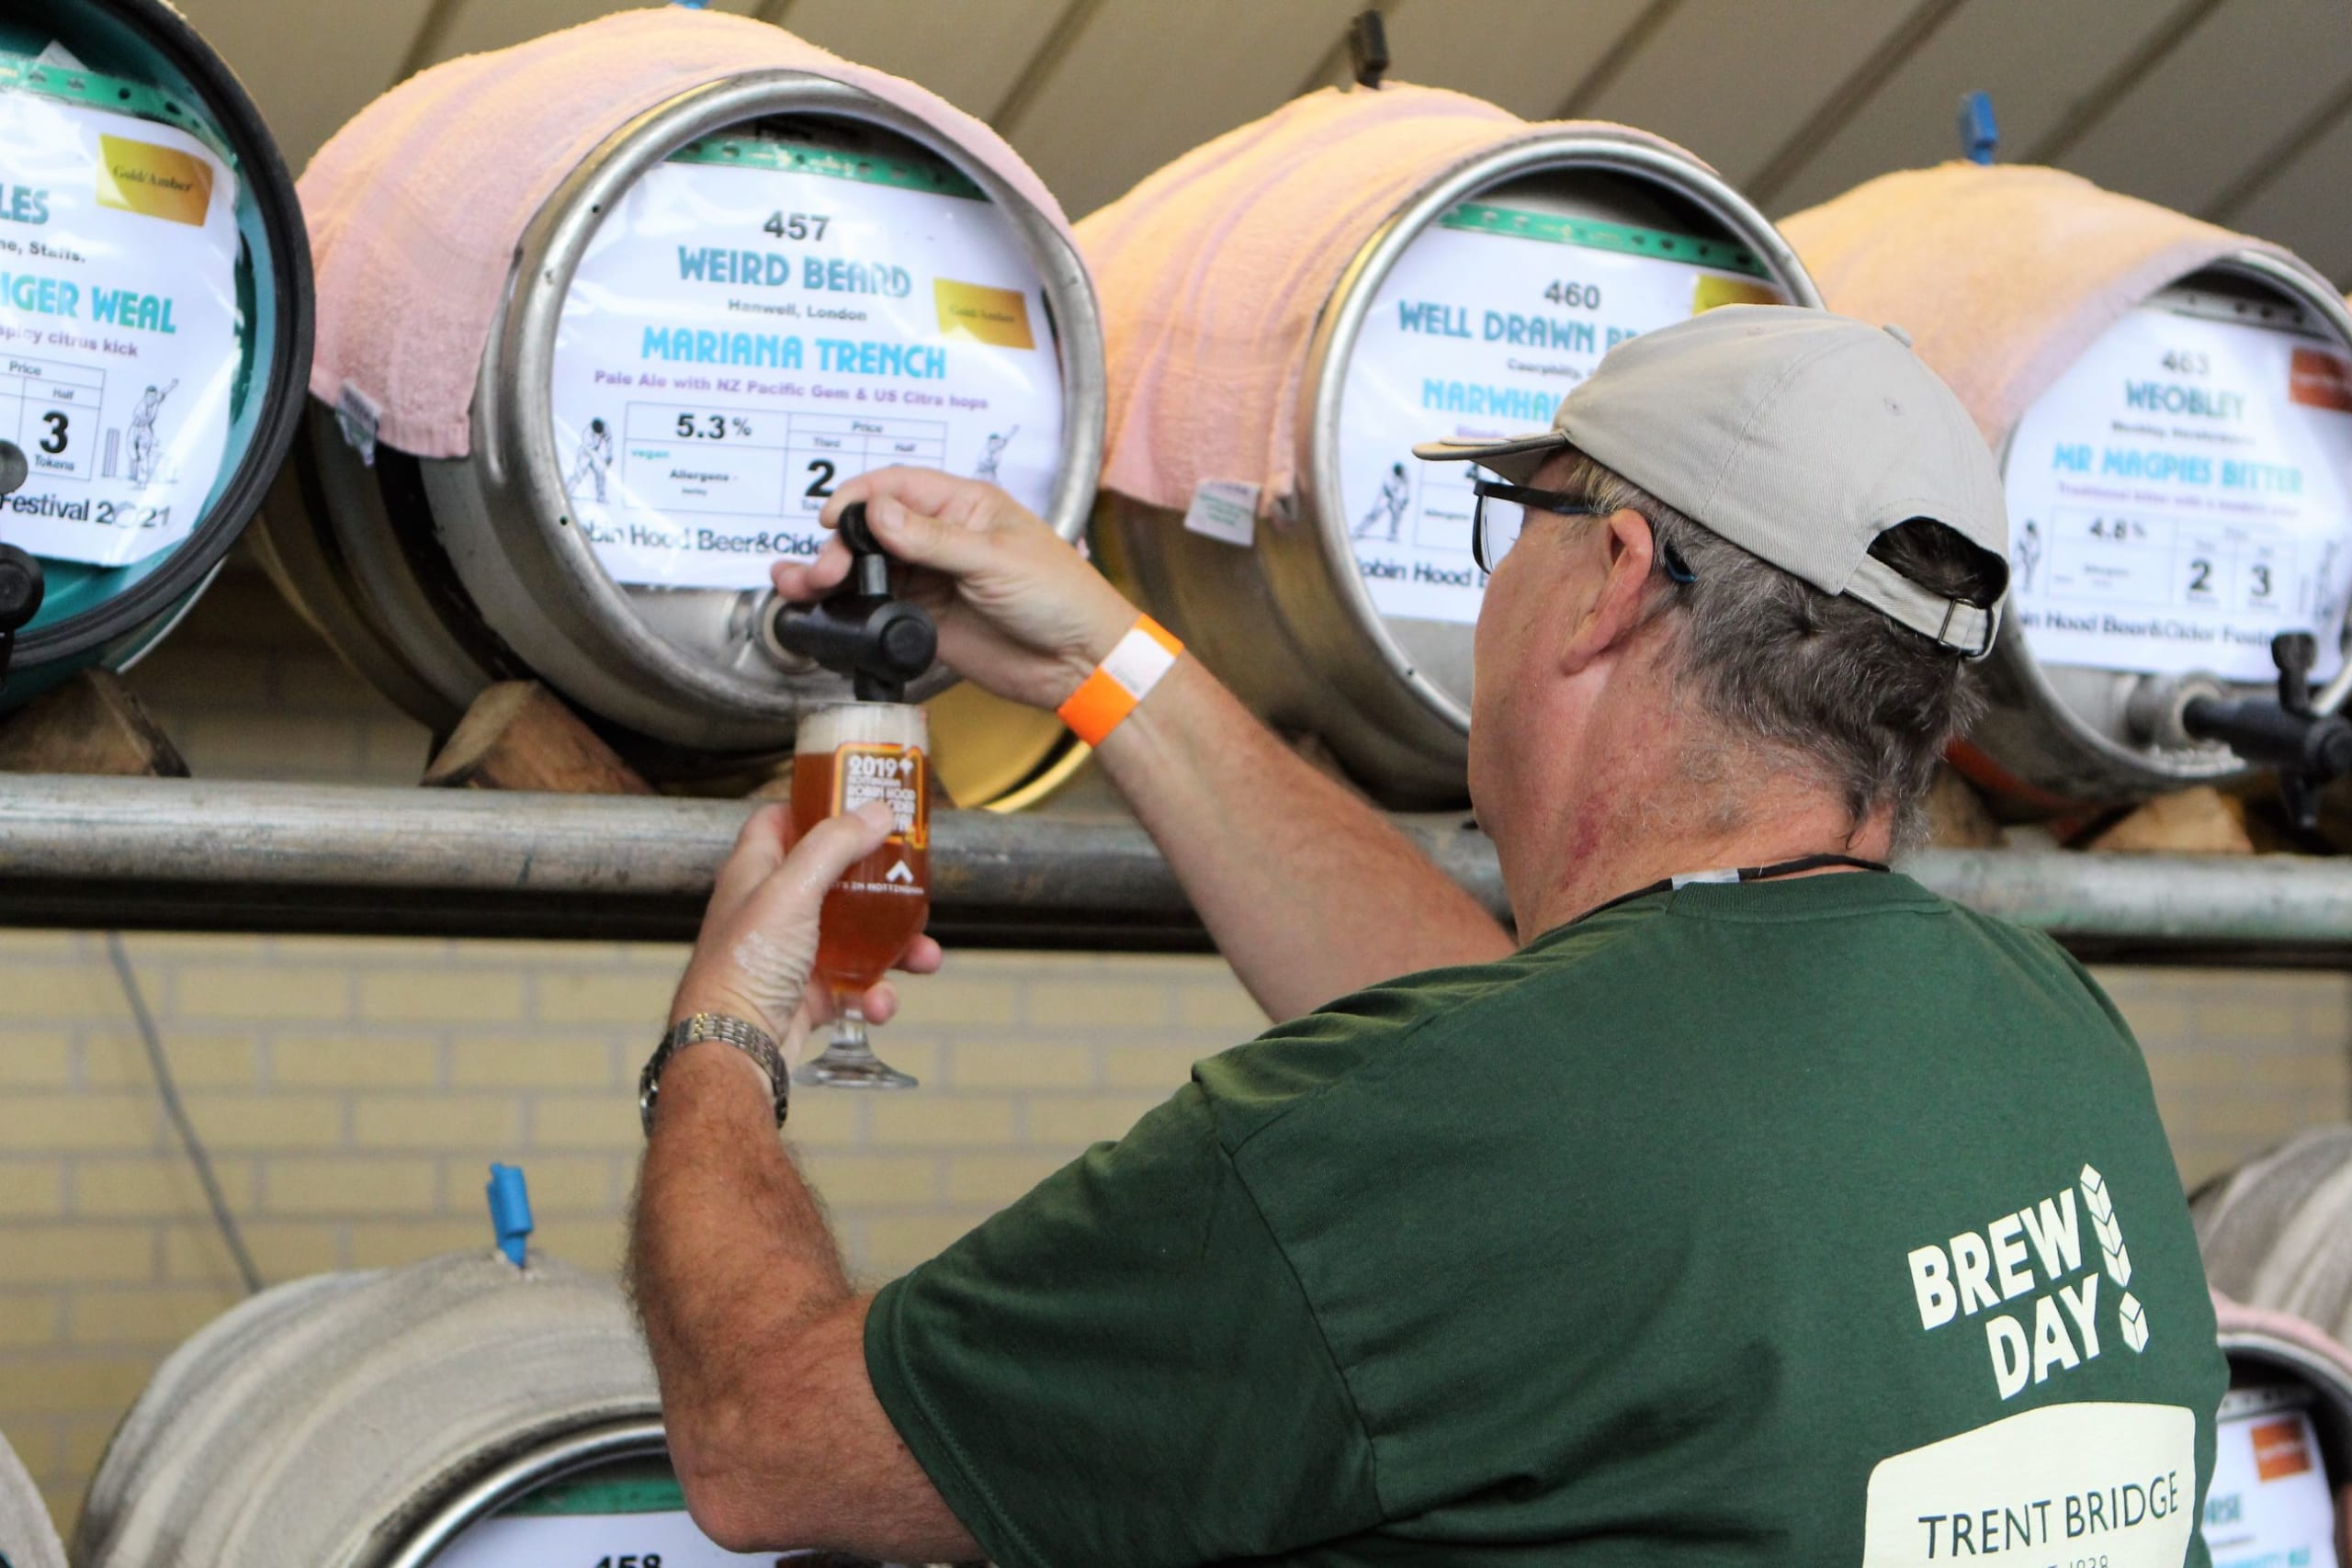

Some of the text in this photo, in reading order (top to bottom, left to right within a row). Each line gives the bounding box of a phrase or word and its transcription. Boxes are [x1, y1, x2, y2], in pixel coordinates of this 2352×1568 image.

[763, 210, 831, 242] 457
[678, 245, 911, 299] WEIRD BEARD
[729, 299, 867, 322] Hanwell, London
[1544, 279, 1600, 310] 460
[92, 287, 176, 335] WEAL
[1398, 299, 1473, 340] WELL
[1484, 310, 1595, 355] DRAWN
[48, 331, 97, 351] citrus
[103, 337, 138, 357] kick
[641, 325, 946, 379] MARIANA TRENCH
[9, 360, 42, 377] Price
[52, 388, 74, 400] Half
[594, 369, 989, 411] Pale Ale with NZ Pacific Gem & US Citra hops
[40, 410, 69, 454] 3
[852, 421, 883, 434] Price
[34, 453, 74, 471] Tokens
[631, 449, 670, 460] vegan
[805, 459, 835, 499] 2
[629, 524, 691, 550] Hood
[1413, 561, 1471, 587] Hood
[2189, 558, 2212, 592] 2
[2250, 564, 2272, 597] 3
[848, 755, 898, 777] 2019
[1907, 1187, 2082, 1331] BREW
[1984, 1271, 2101, 1401] DAY
[1917, 1498, 2052, 1560] TRENT
[2064, 1470, 2178, 1539] BRIDGE
